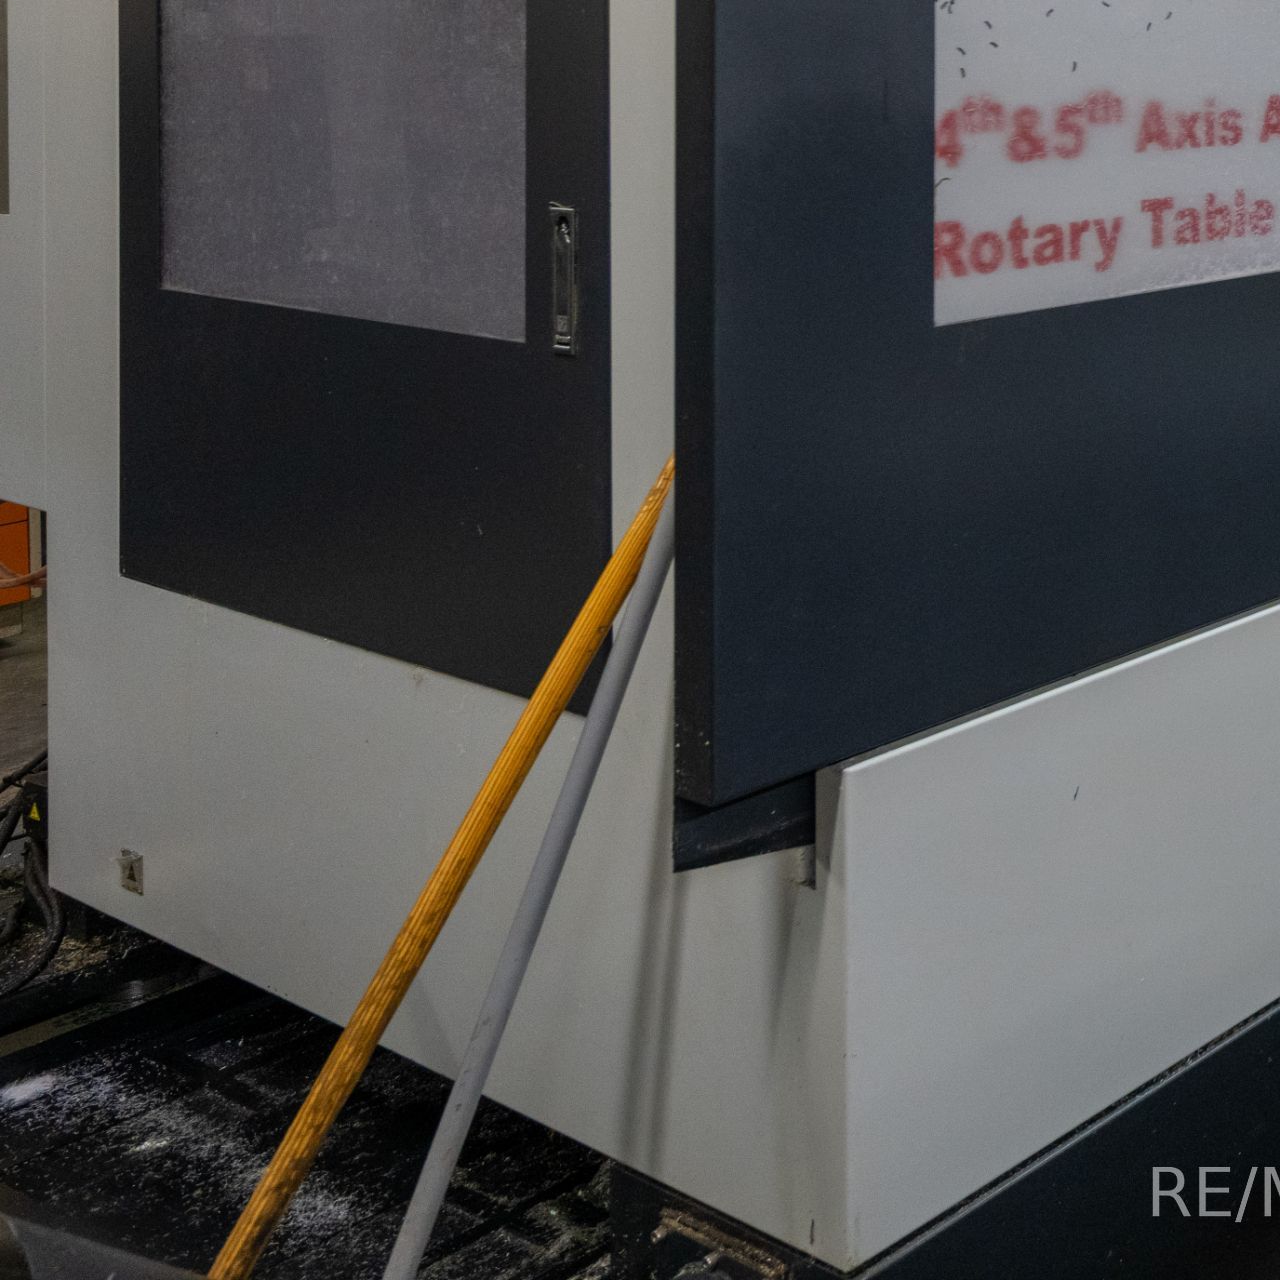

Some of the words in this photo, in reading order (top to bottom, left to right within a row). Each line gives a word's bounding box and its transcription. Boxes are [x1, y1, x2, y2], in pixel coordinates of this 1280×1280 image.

[1135, 99, 1243, 153] Axis
[935, 216, 1123, 279] Rotary
[1141, 189, 1274, 248] Table
